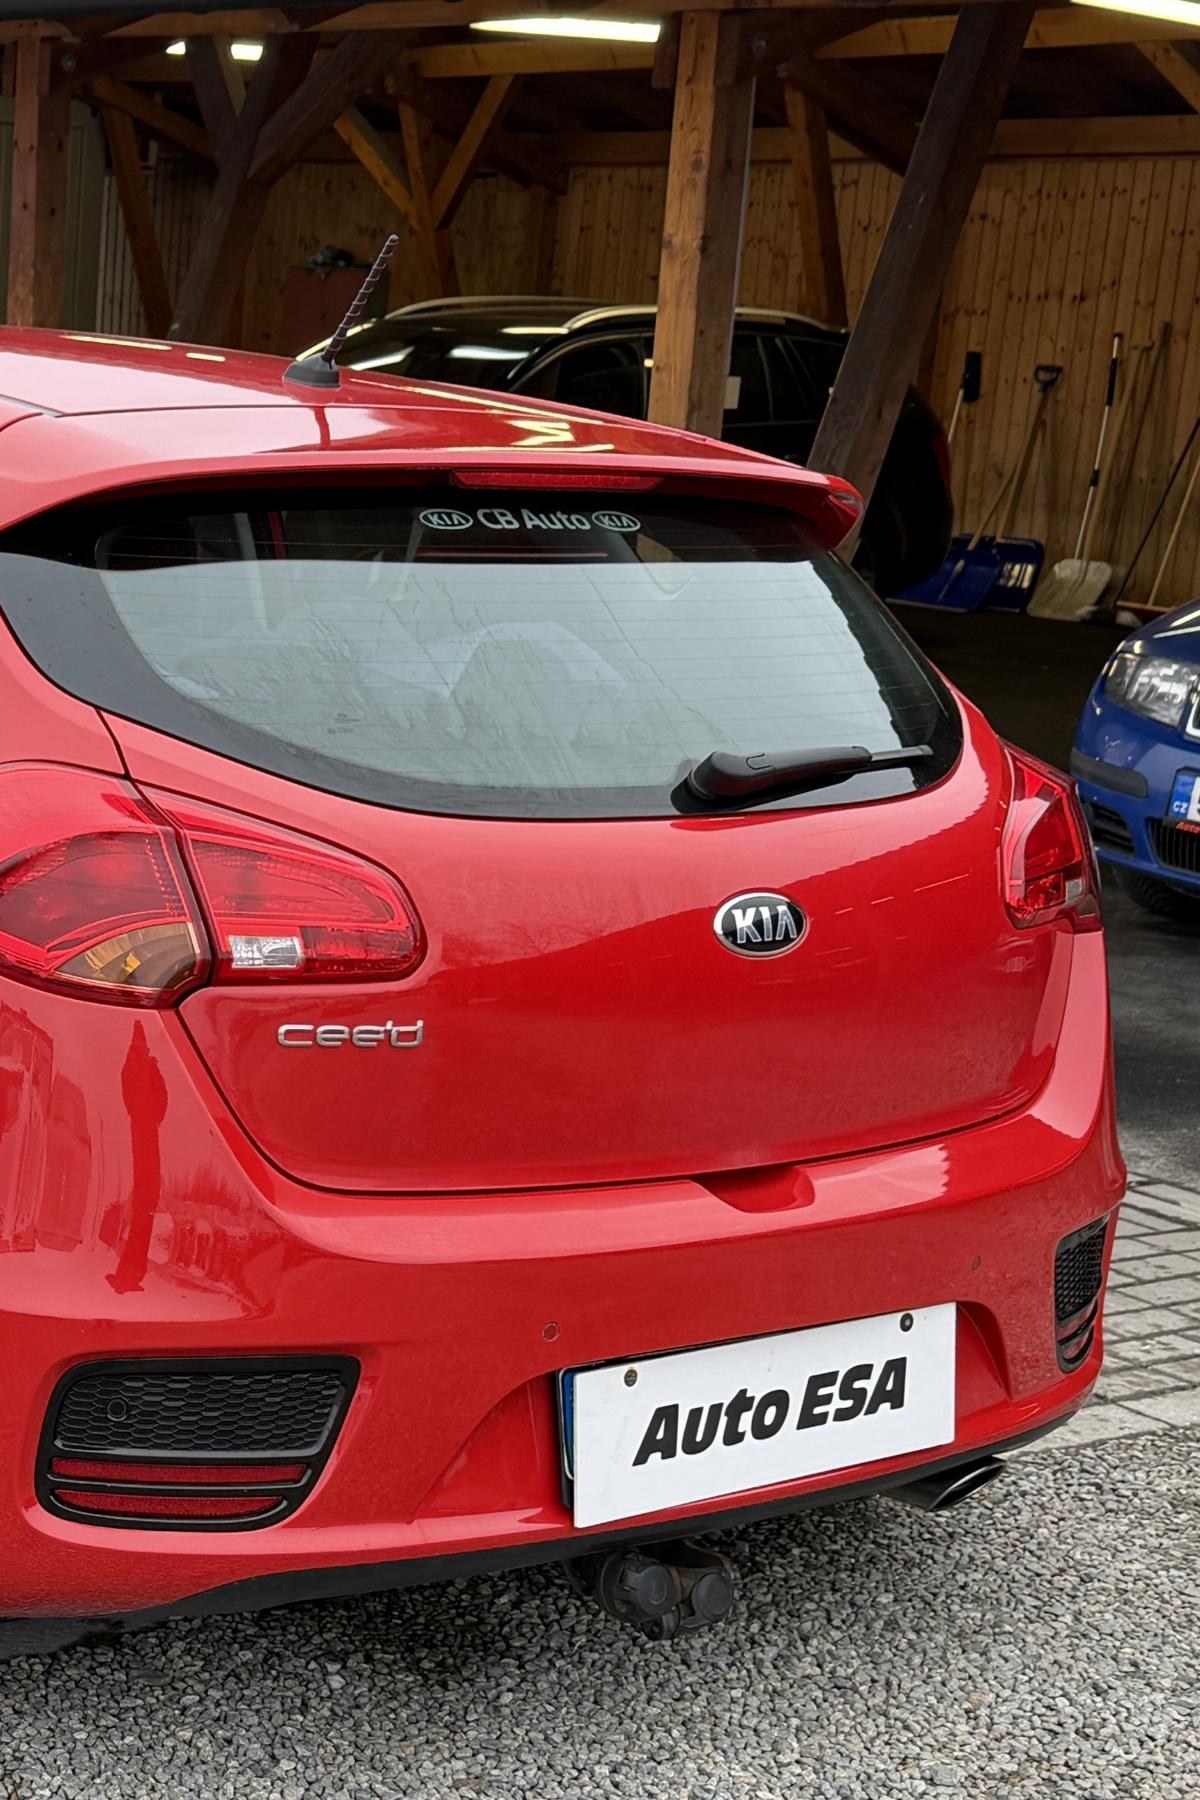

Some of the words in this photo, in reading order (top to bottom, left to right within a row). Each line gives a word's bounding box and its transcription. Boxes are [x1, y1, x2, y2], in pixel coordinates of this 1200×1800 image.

[477, 508, 520, 529] CB
[521, 508, 592, 530] Auto
[1172, 800, 1188, 814] CZ
[731, 904, 798, 944] KIA
[631, 1388, 790, 1467] Auto
[795, 1356, 908, 1431] ESA
